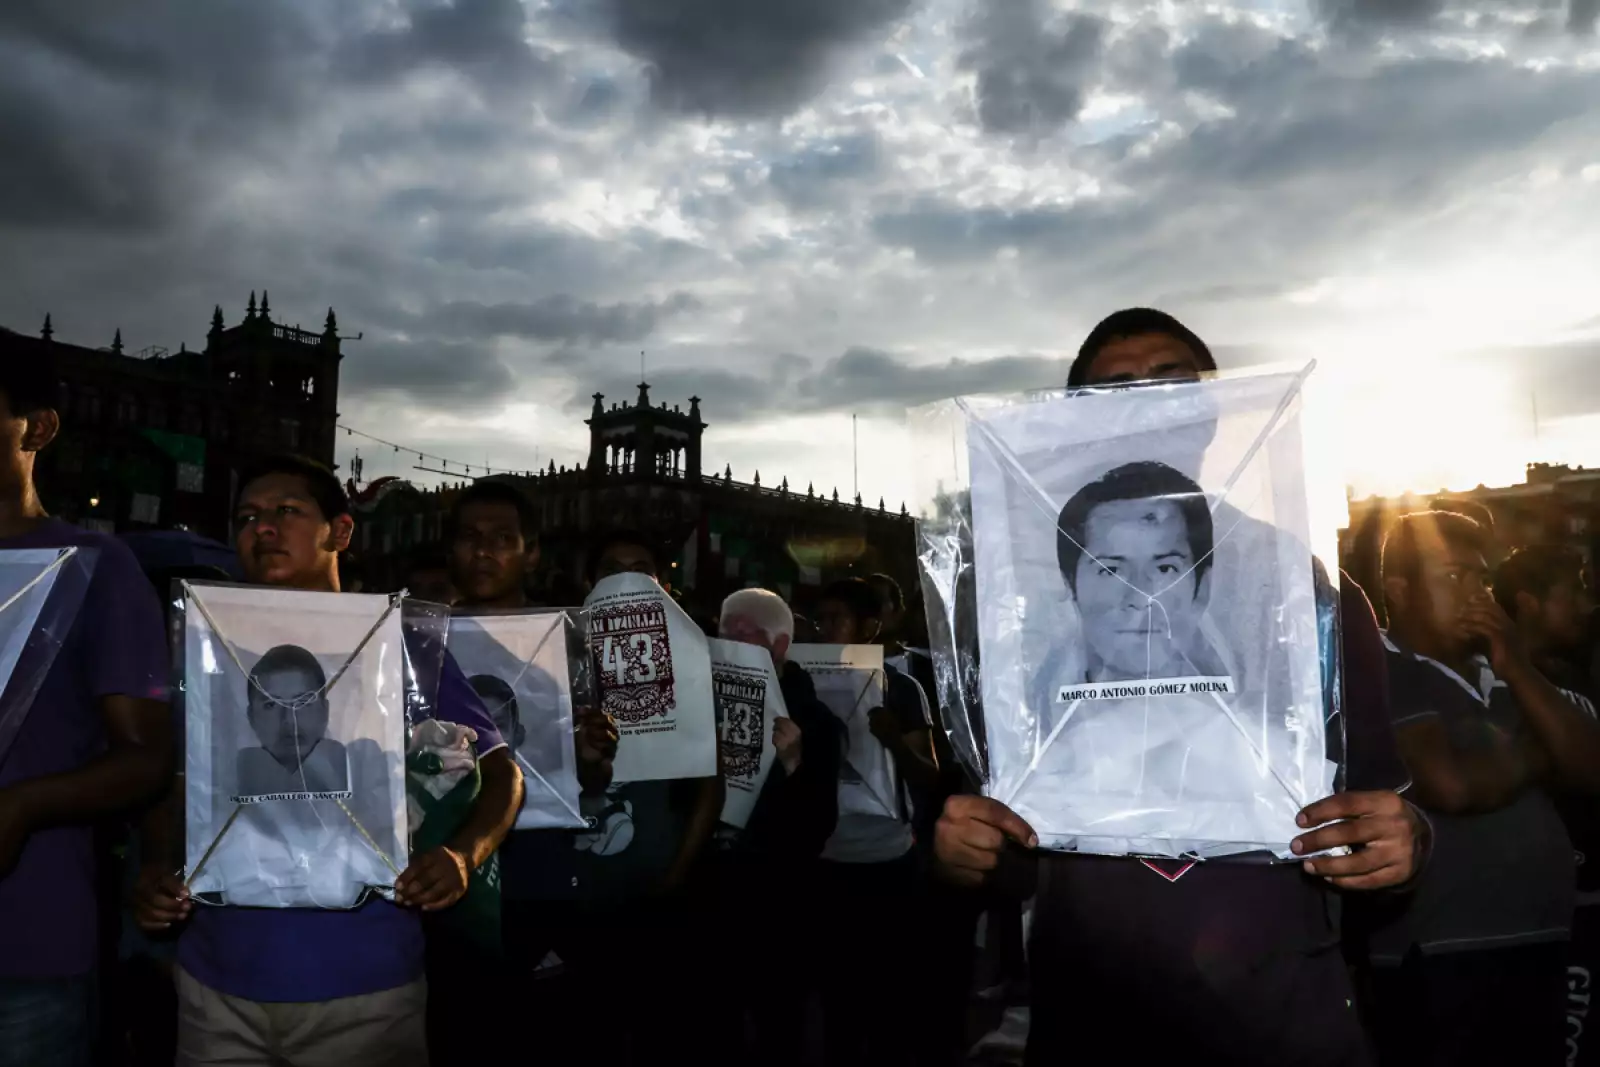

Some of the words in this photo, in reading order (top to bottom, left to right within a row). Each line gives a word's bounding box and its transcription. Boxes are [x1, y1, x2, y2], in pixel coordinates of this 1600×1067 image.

[603, 633, 657, 685] 43
[1061, 690, 1097, 701] MARCO
[1100, 685, 1146, 698] ANTONIO
[1149, 682, 1187, 696] GÓMEZ
[1190, 682, 1228, 693] MOLINA
[260, 794, 310, 802] CABALLERO
